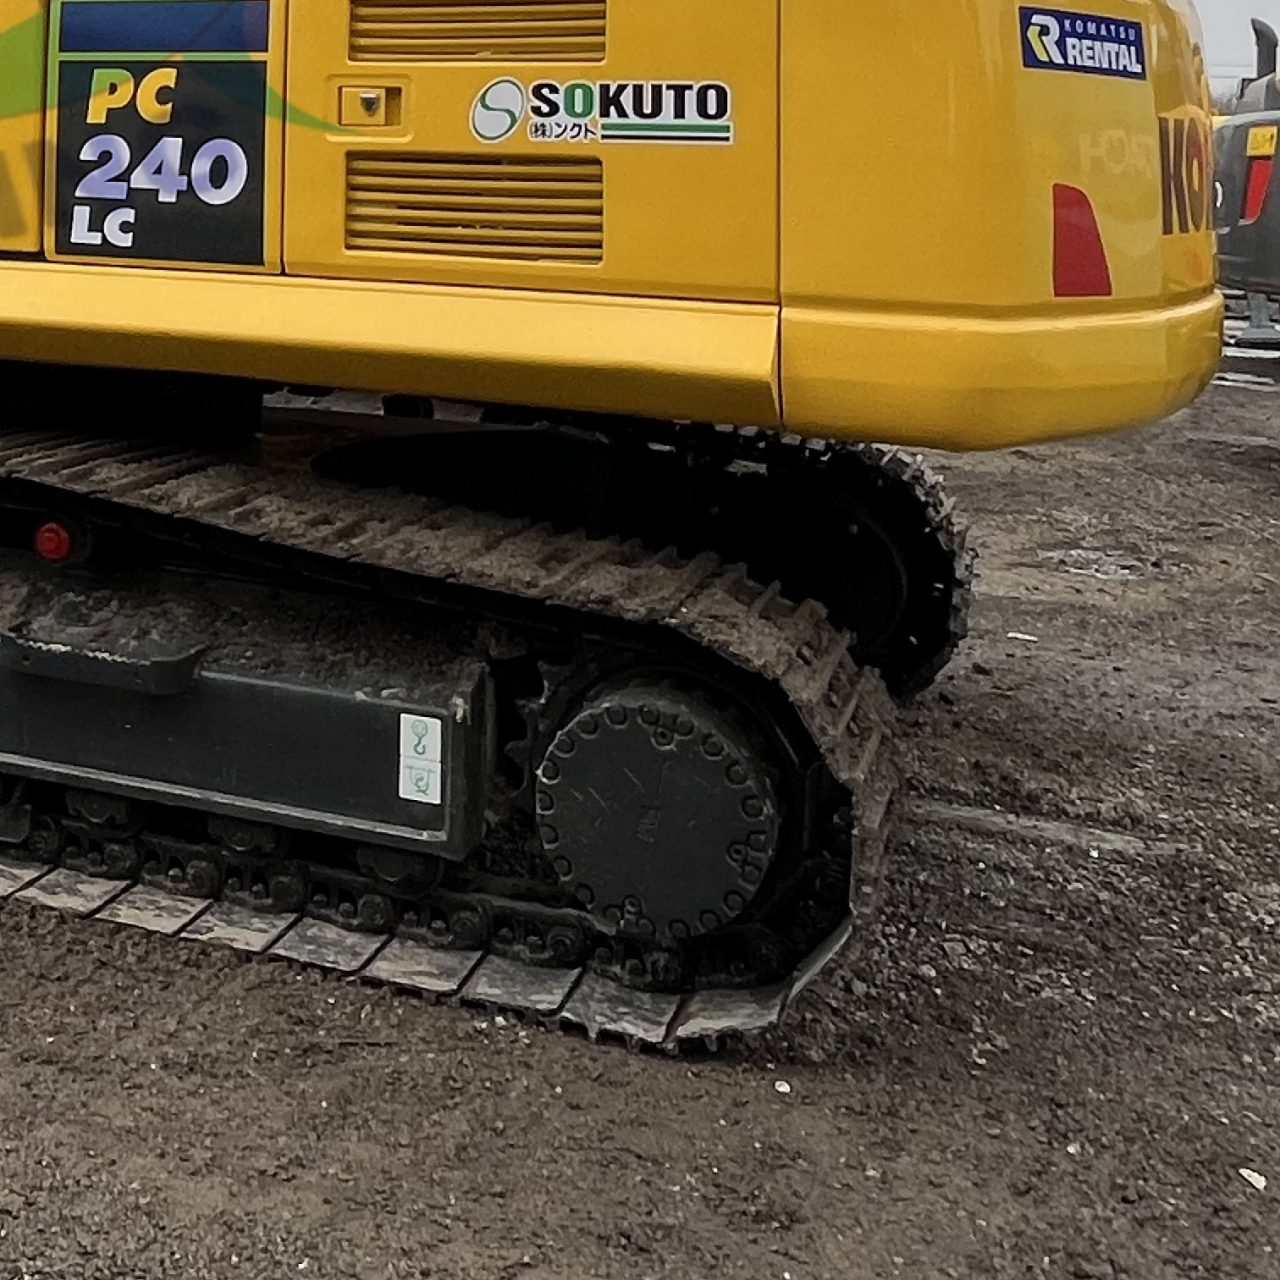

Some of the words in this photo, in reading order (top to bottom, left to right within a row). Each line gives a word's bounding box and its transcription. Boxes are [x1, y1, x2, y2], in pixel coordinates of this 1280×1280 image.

[1063, 18, 1136, 41] KOMATSU
[1065, 37, 1143, 73] RENTAL
[86, 67, 177, 124] PC
[530, 82, 728, 120] SOKUTO
[74, 134, 247, 206] 240
[1158, 116, 1213, 235] KO
[70, 204, 136, 248] LC
